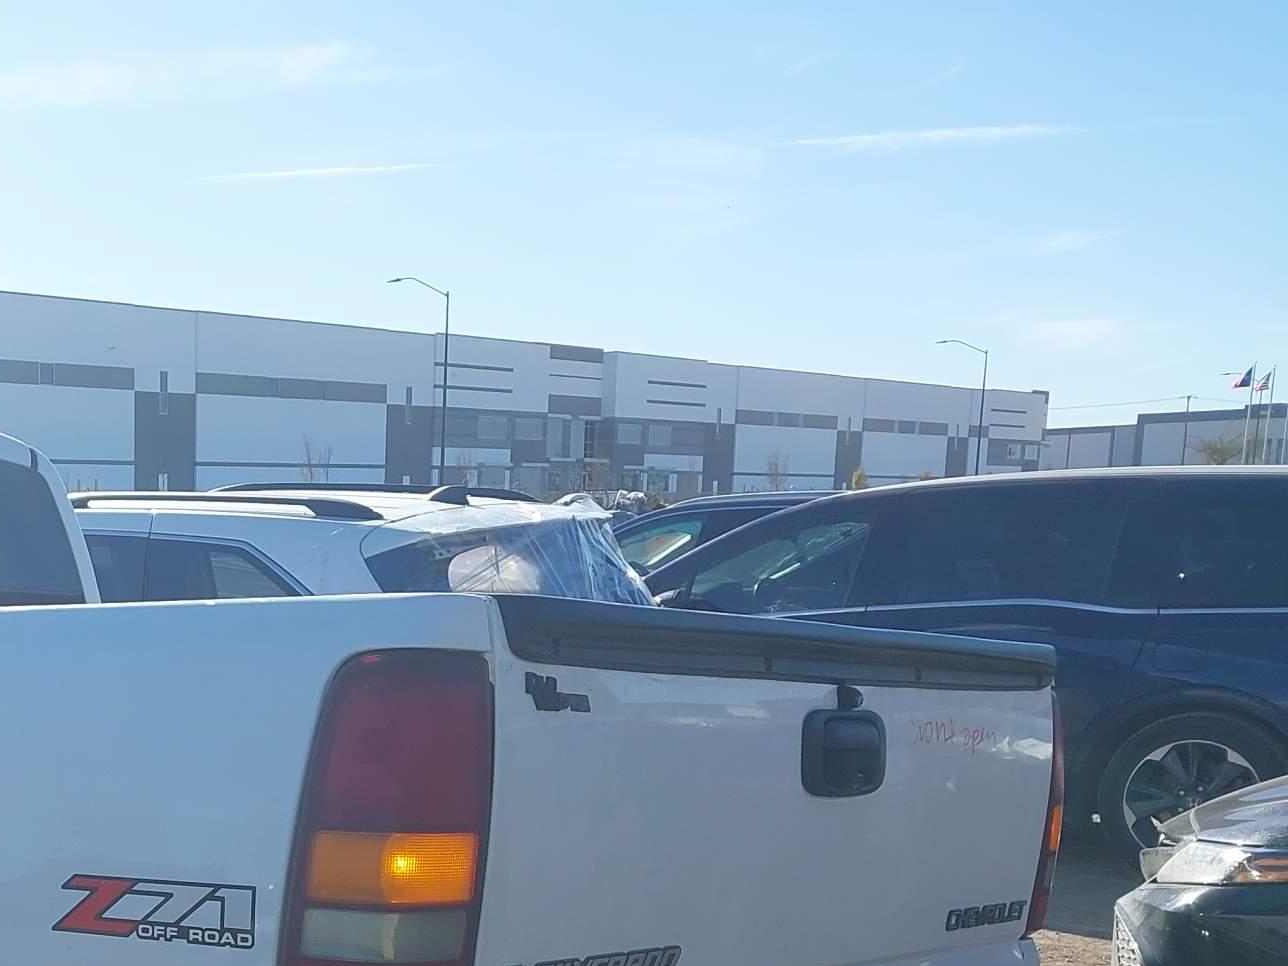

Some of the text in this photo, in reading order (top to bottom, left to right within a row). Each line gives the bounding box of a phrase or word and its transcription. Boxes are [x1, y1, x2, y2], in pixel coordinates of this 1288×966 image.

[52, 874, 256, 938] Z71
[946, 900, 1027, 931] CHEVROLET
[137, 923, 254, 947] OFF ROAD
